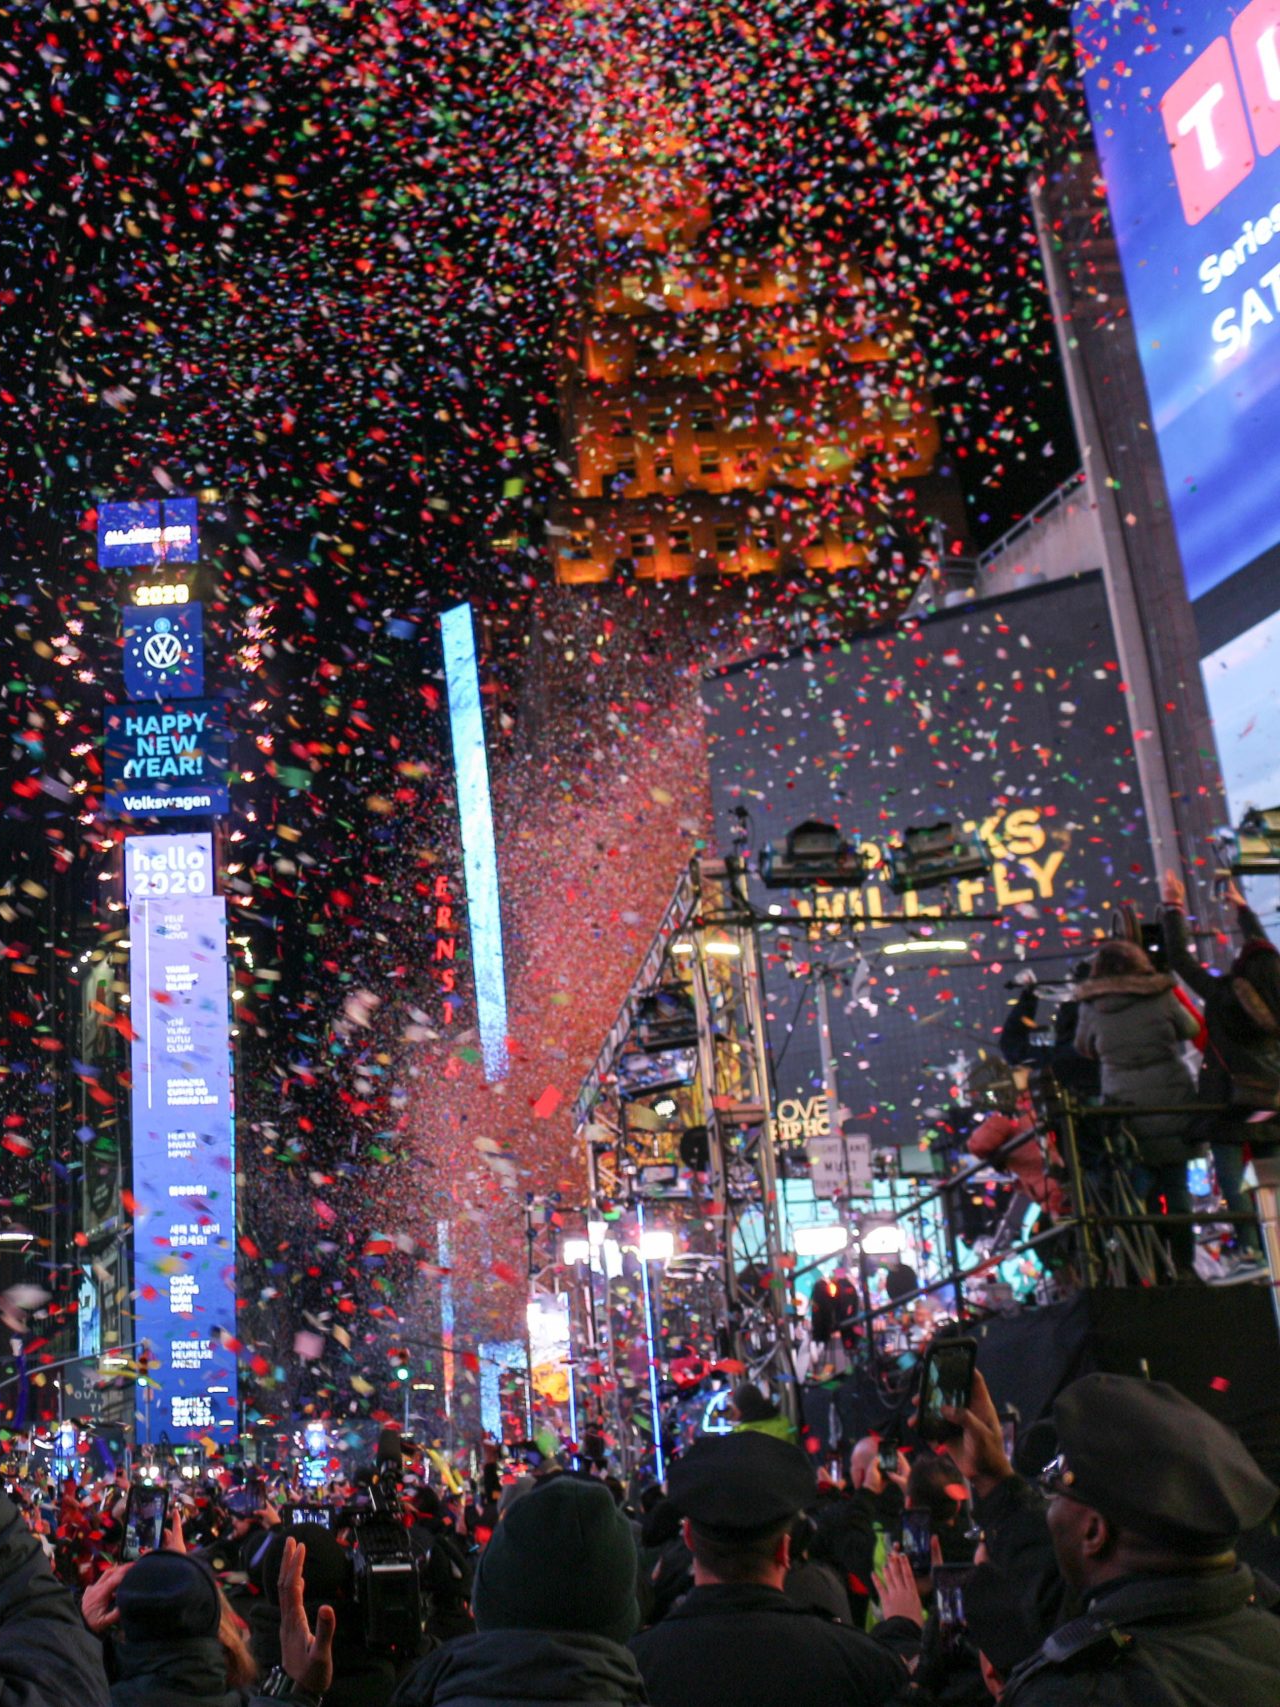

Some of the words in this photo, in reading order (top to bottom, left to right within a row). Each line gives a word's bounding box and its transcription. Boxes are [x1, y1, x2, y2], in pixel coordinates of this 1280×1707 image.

[135, 583, 190, 606] 2020
[125, 712, 208, 737] HAPPY
[136, 734, 197, 758] NEW
[131, 756, 204, 779] YEAR!
[123, 794, 211, 811] Volkswagen
[133, 846, 204, 872] hello
[133, 871, 206, 896] 2020
[777, 1097, 829, 1123] OVE
